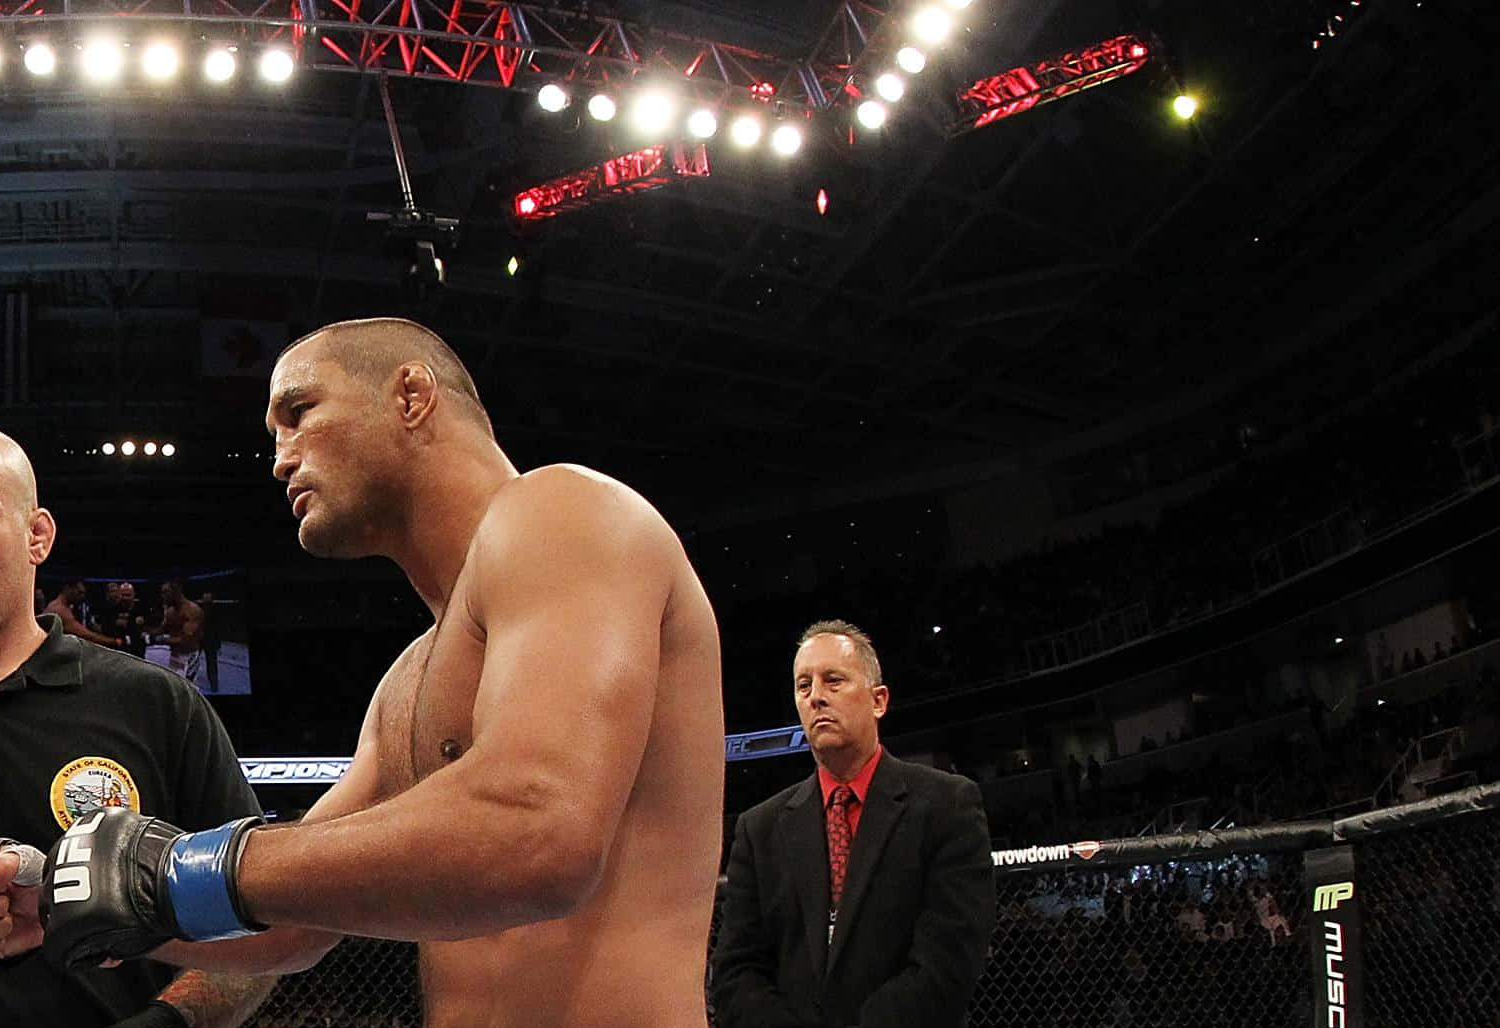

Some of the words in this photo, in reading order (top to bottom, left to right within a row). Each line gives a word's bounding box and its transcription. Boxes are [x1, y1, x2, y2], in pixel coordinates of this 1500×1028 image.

[63, 764, 81, 777] STATE
[98, 761, 134, 792] CALIFORNIA
[54, 812, 105, 904] UFC
